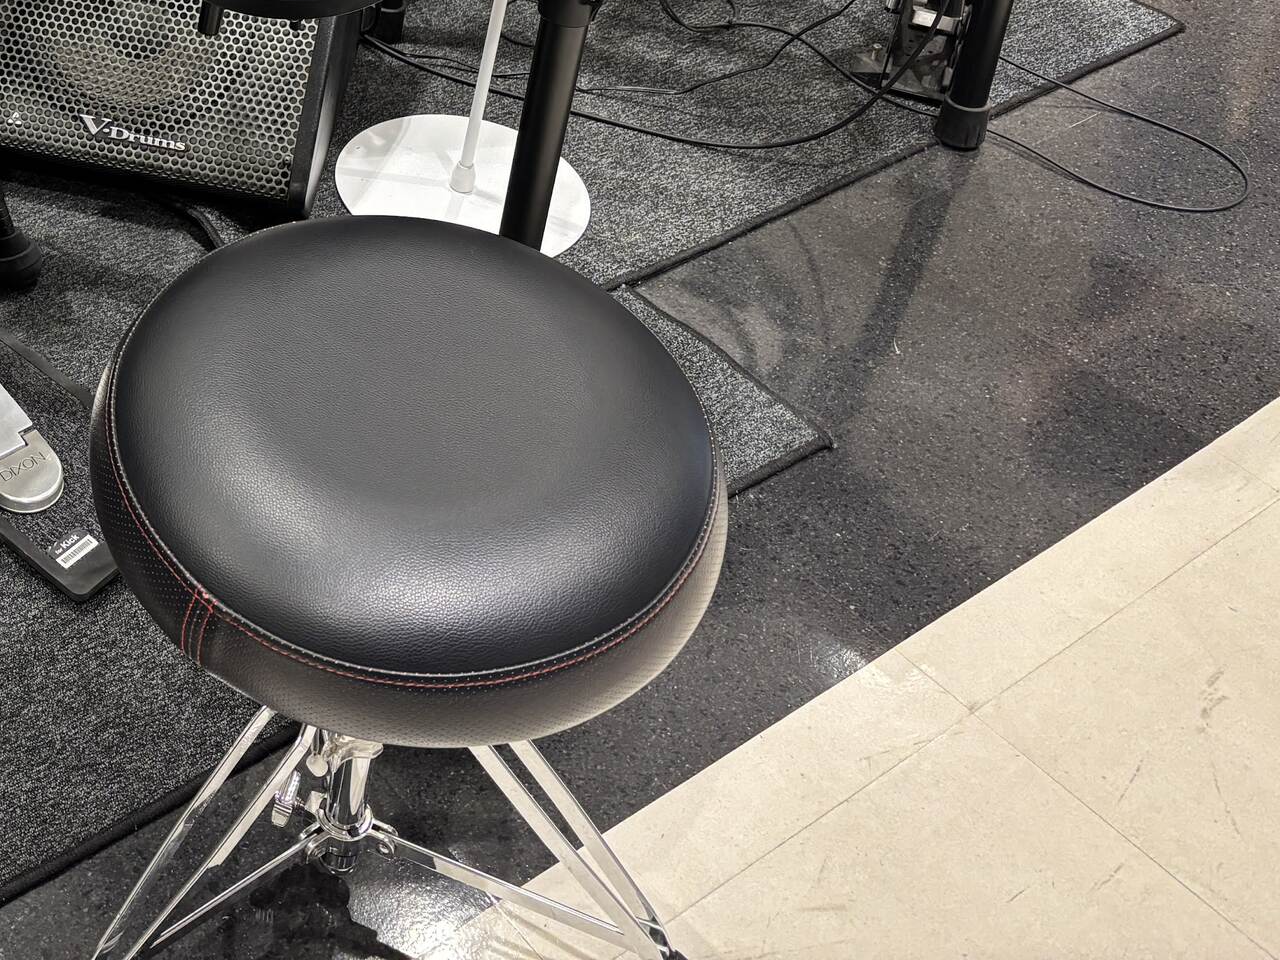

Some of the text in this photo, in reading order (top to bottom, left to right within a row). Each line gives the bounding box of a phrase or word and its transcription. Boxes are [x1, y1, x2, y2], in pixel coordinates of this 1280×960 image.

[79, 114, 187, 152] V-Drums
[0, 450, 45, 482] DIXON
[60, 532, 80, 550] Kick
